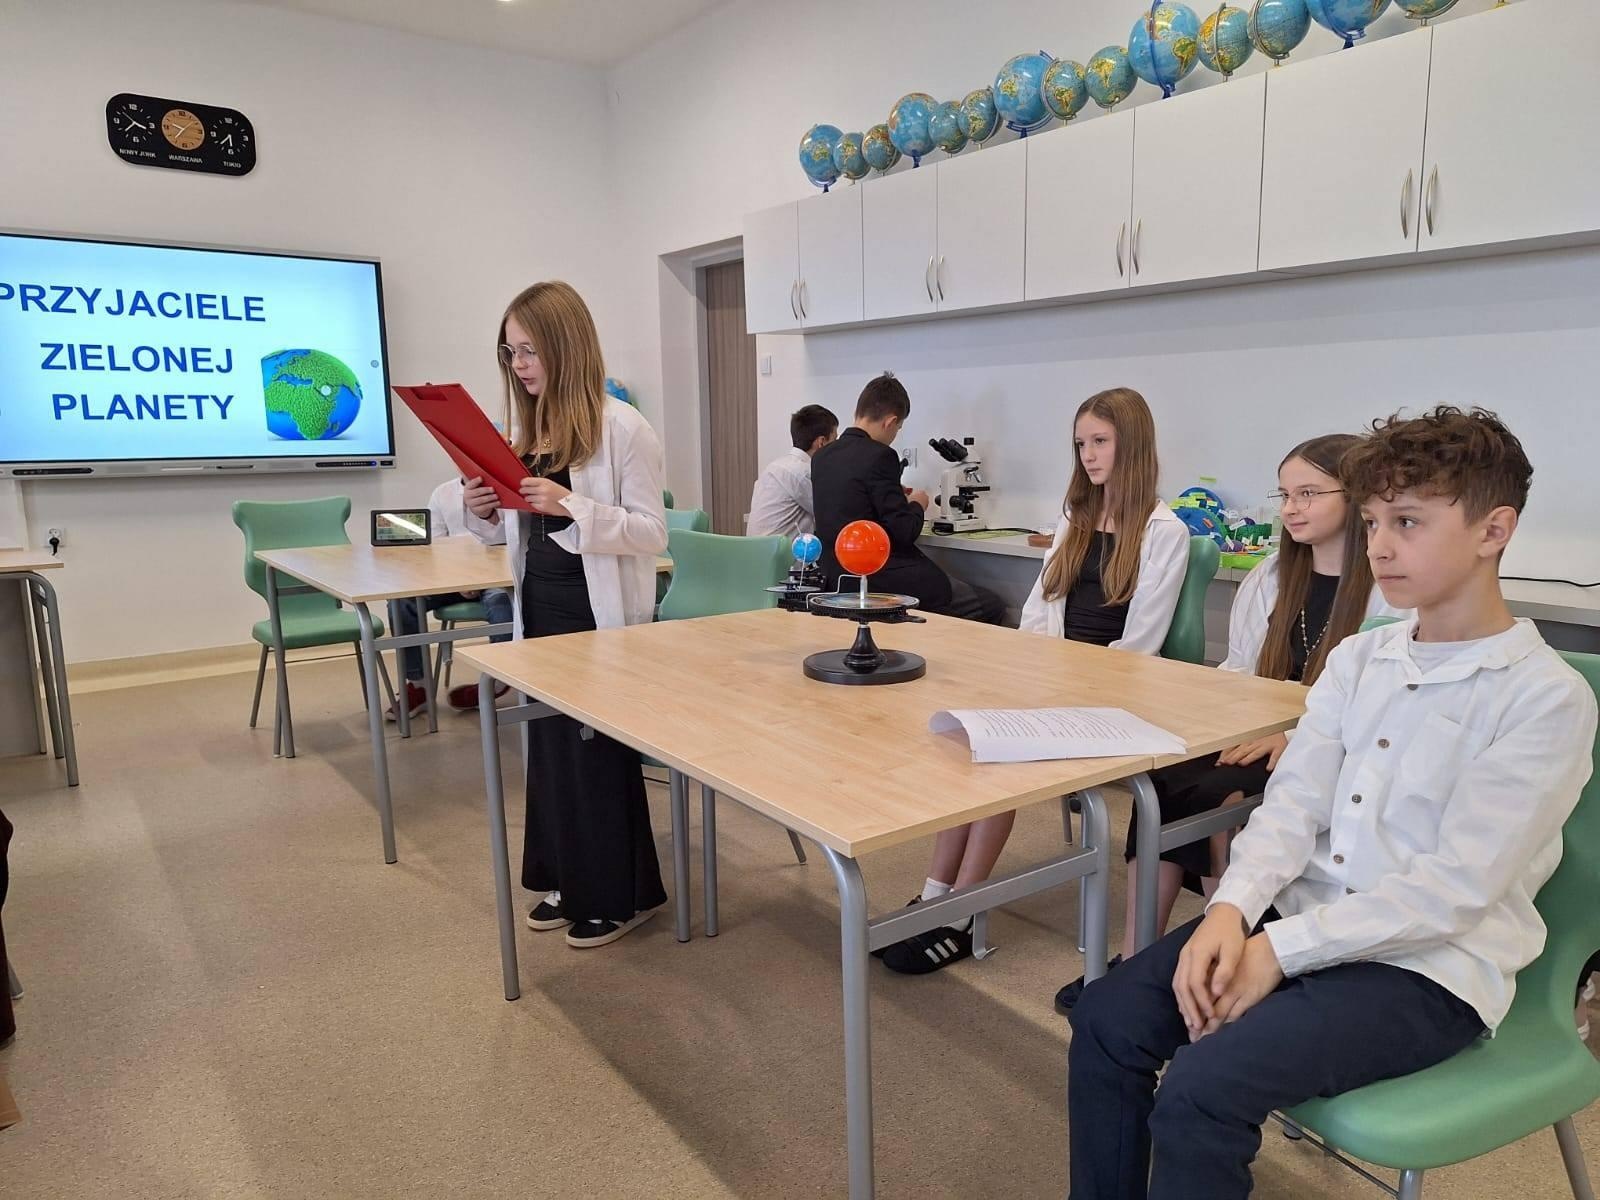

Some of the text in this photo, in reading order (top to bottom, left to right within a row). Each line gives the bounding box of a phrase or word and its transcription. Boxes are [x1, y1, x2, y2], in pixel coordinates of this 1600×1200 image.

[168, 154, 203, 164] WARSZAWA
[40, 342, 233, 374] ZIELONEJ
[52, 393, 234, 420] PLANETY
